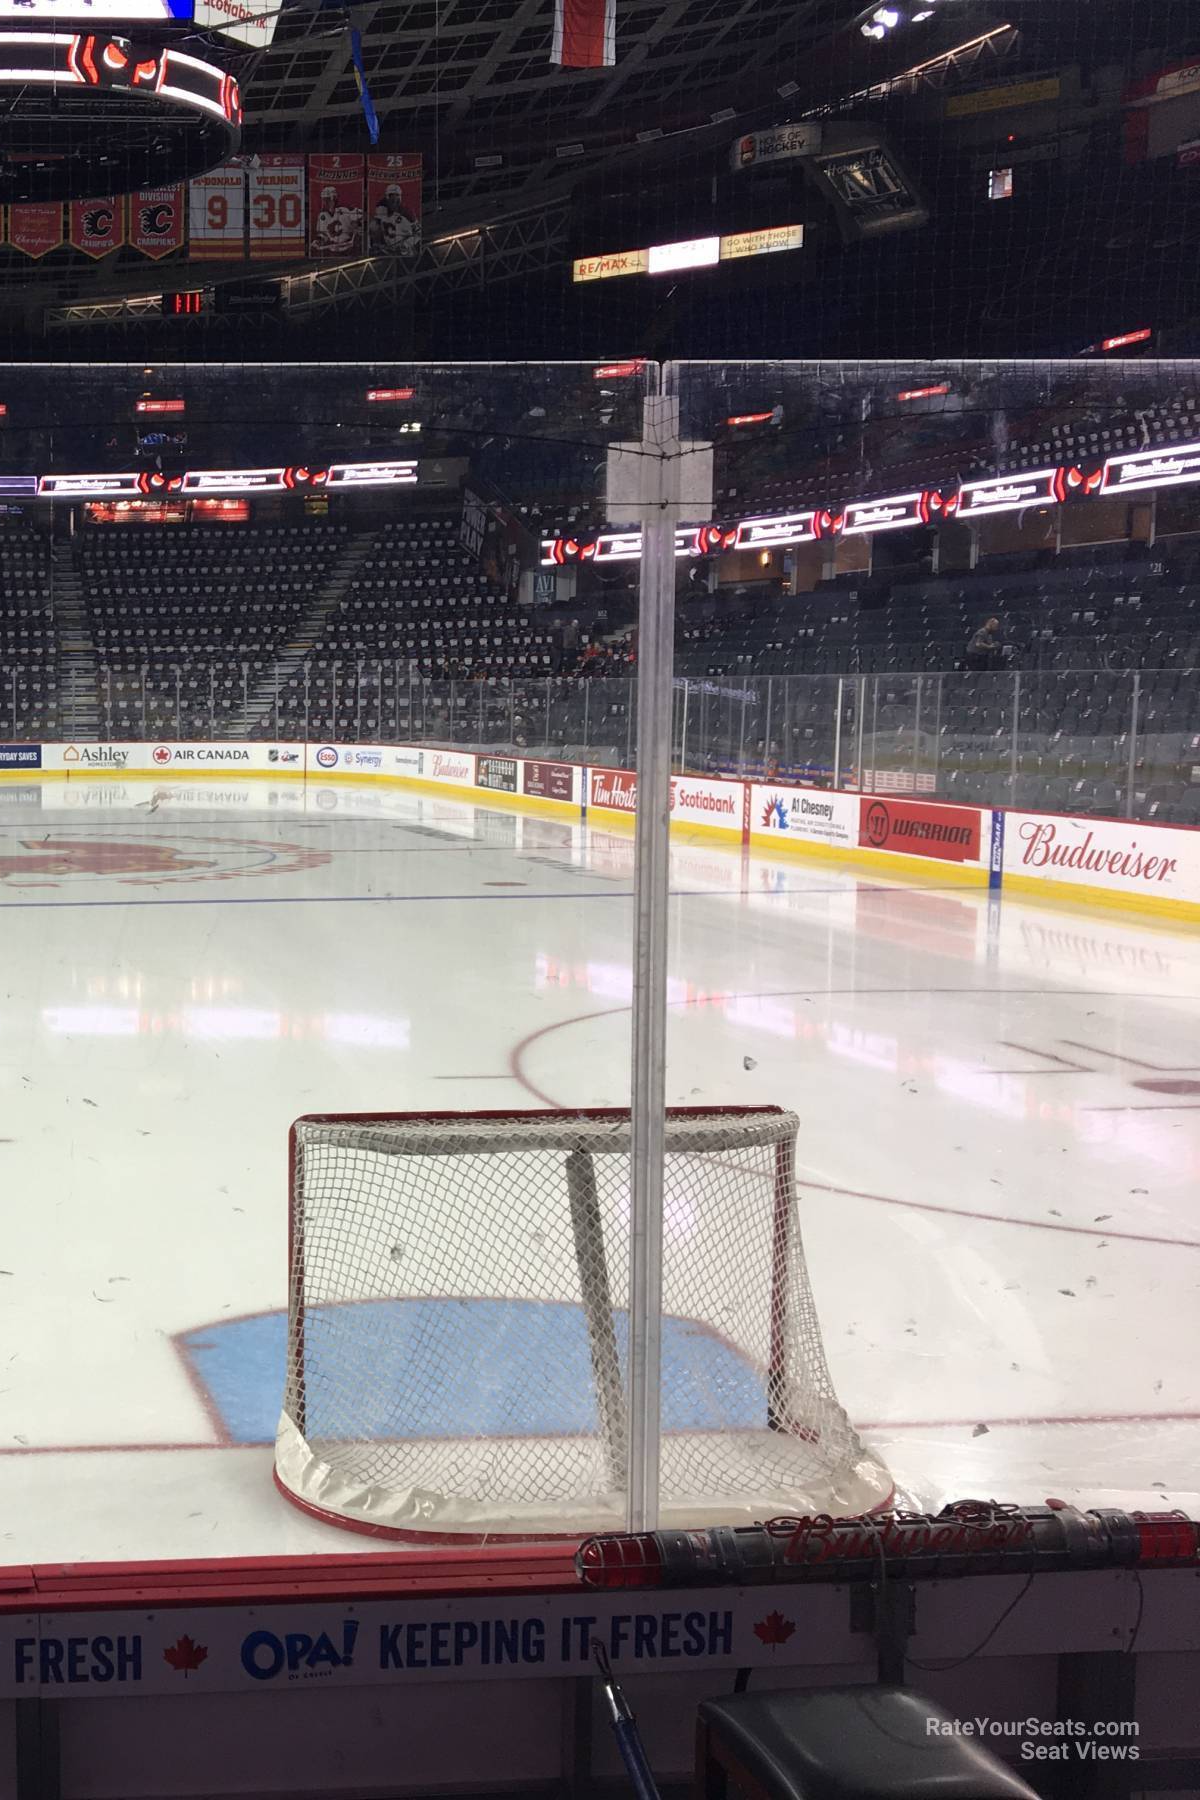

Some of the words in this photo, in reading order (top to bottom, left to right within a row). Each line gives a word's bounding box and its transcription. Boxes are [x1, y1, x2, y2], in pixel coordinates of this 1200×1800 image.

[760, 139, 806, 156] HOCKEY
[255, 176, 299, 186] VERNON
[139, 191, 175, 201] DIVISION
[207, 195, 228, 230] 9
[253, 193, 301, 229] 30
[742, 234, 766, 245] WITH
[767, 229, 798, 241] THOSE
[18, 752, 38, 761] SAVES
[80, 746, 129, 763] Ashley
[174, 750, 194, 760] AIR
[197, 750, 249, 760] CANADA
[320, 752, 336, 761] Esso
[355, 753, 382, 767] Synergy
[593, 774, 611, 804] Tim
[679, 789, 735, 815] Scotiabank
[801, 798, 834, 821] Chesney
[892, 818, 973, 846] WARRIOR
[1019, 822, 1177, 881] Budweiser
[240, 1619, 360, 1680] OPA!
[380, 1618, 545, 1669] KEEPING
[561, 1616, 597, 1661] IT
[611, 1610, 734, 1659] FRESH
[15, 1635, 142, 1684] FRESH
